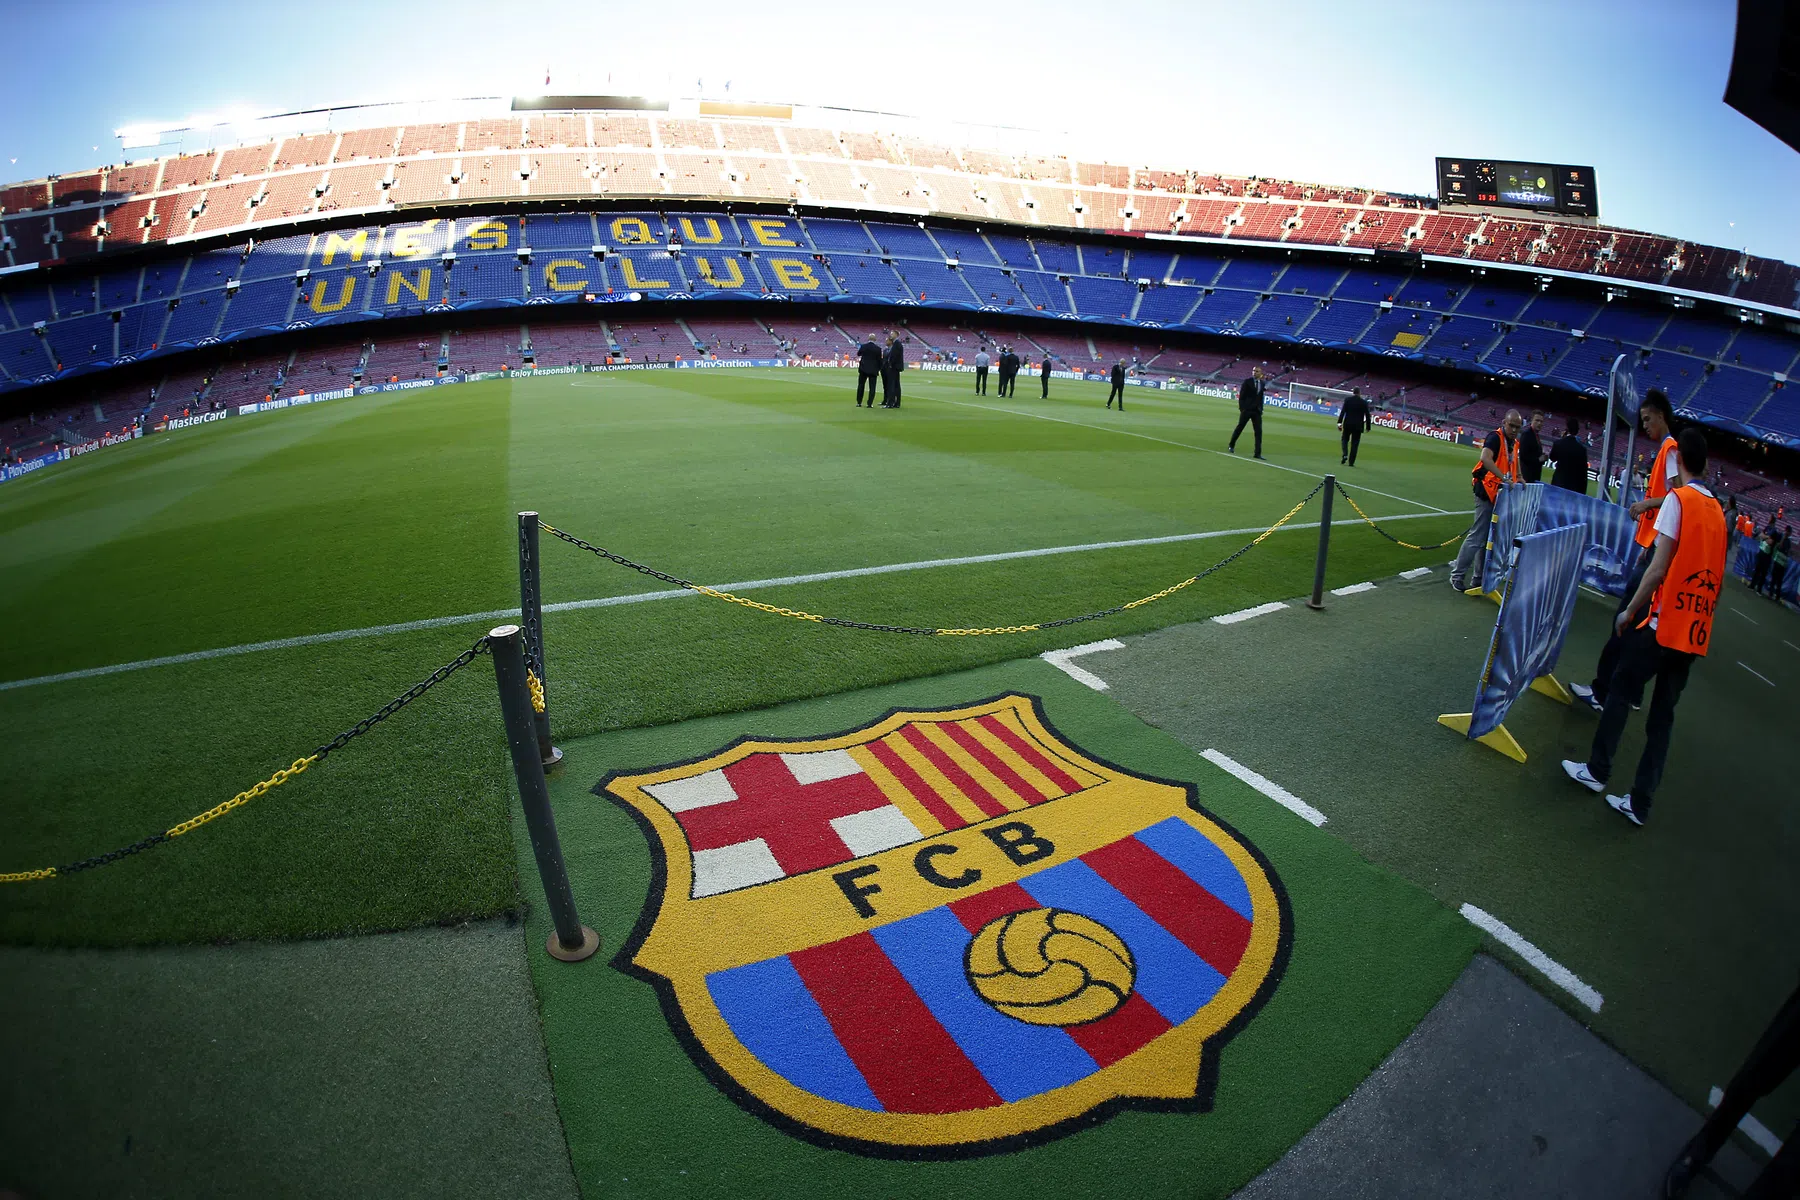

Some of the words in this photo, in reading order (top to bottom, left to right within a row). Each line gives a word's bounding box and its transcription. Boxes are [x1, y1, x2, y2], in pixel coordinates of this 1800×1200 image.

[611, 216, 798, 247] QUE
[310, 267, 432, 313] UN
[544, 257, 820, 291] CLUB
[510, 370, 531, 378] Enjoy
[534, 365, 578, 376] Responsibly
[590, 364, 607, 372] UEFA
[608, 363, 645, 371] CHAMPIONS
[646, 362, 669, 370] LEAGUE
[801, 360, 838, 368] UniCredit
[922, 362, 977, 373] MasterCard
[383, 383, 399, 391] NEW
[400, 379, 434, 389] TOURNEO
[1194, 385, 1232, 400] Heineken
[314, 390, 344, 402] GAZPROM
[260, 399, 289, 412] GAZPROM
[168, 409, 227, 430] MasterCard
[1364, 414, 1399, 429] iCredit
[106, 431, 132, 447] UniCredit
[1411, 423, 1452, 441] UniCredit
[76, 440, 100, 455] UniCredit
[8, 458, 45, 479] PlayStation
[831, 821, 1055, 919] FCB
